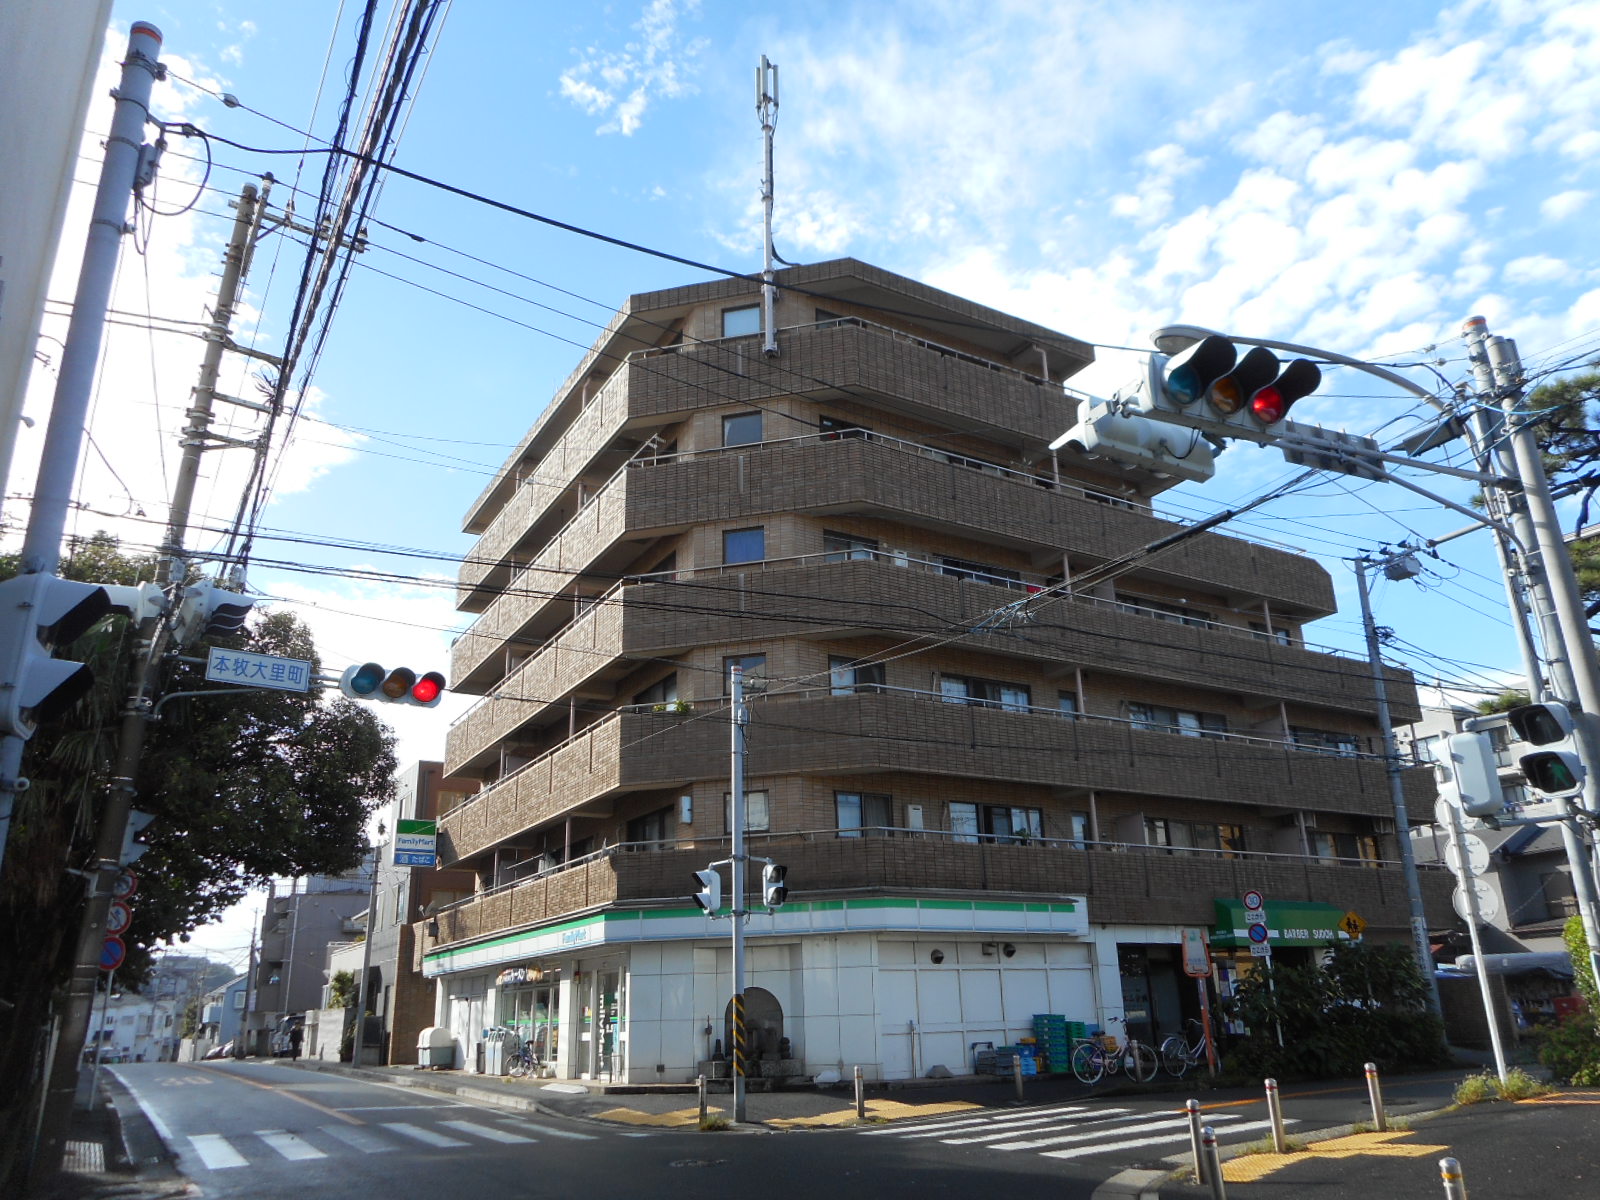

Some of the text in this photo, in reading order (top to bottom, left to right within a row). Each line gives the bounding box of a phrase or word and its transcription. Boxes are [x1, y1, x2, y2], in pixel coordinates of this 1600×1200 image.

[213, 655, 304, 684] 本牧大里町
[398, 837, 434, 846] FamilyMart
[1247, 895, 1259, 906] 30
[562, 928, 587, 945] FamilyMart
[1283, 928, 1310, 939] BARBER
